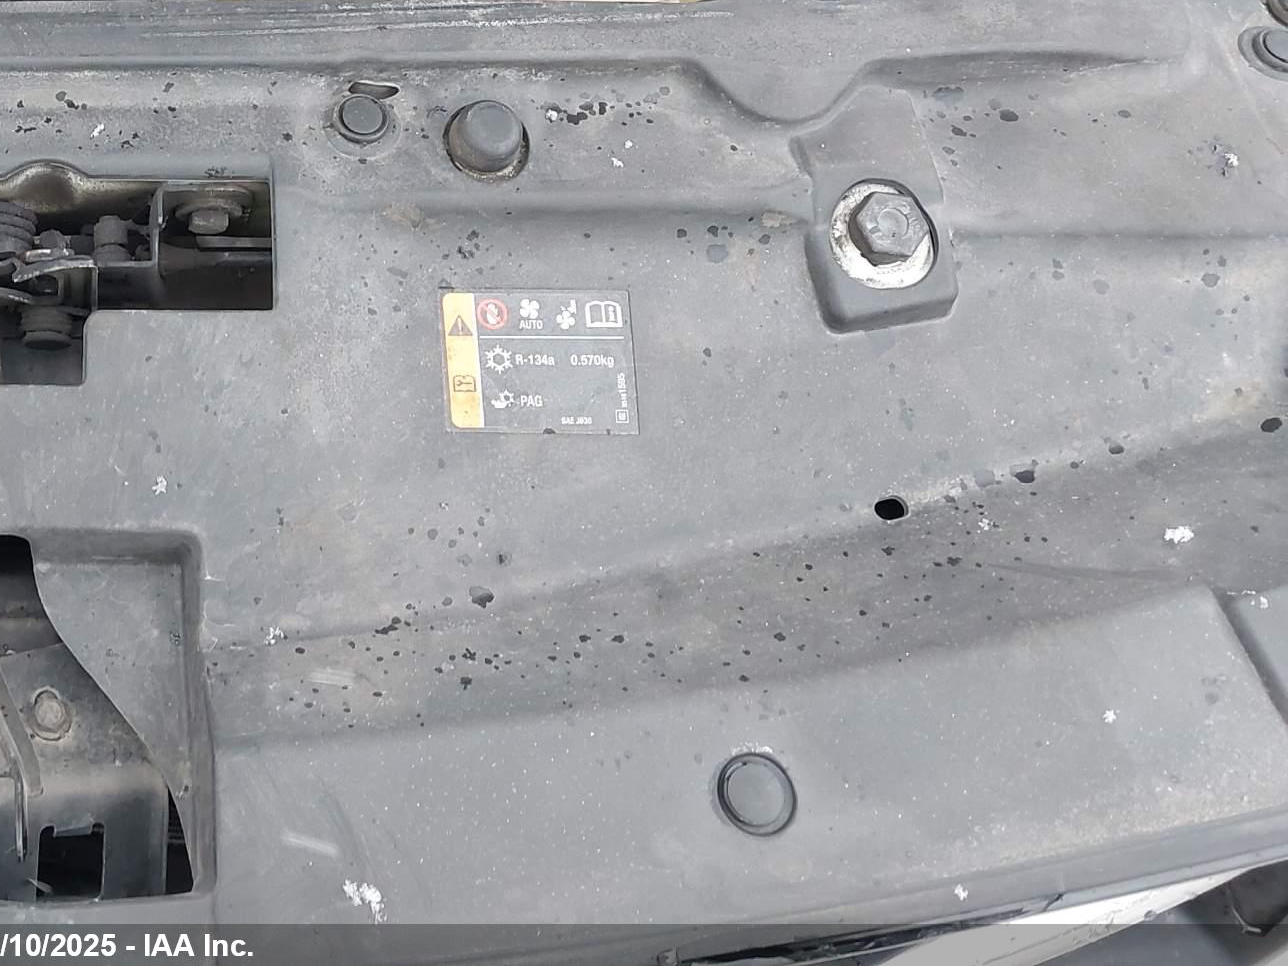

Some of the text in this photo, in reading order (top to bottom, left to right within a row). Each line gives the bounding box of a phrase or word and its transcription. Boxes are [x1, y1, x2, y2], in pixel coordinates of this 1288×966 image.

[519, 320, 543, 330] AUTO
[515, 354, 615, 368] R-134a 0.570kg
[520, 394, 543, 407] PAG
